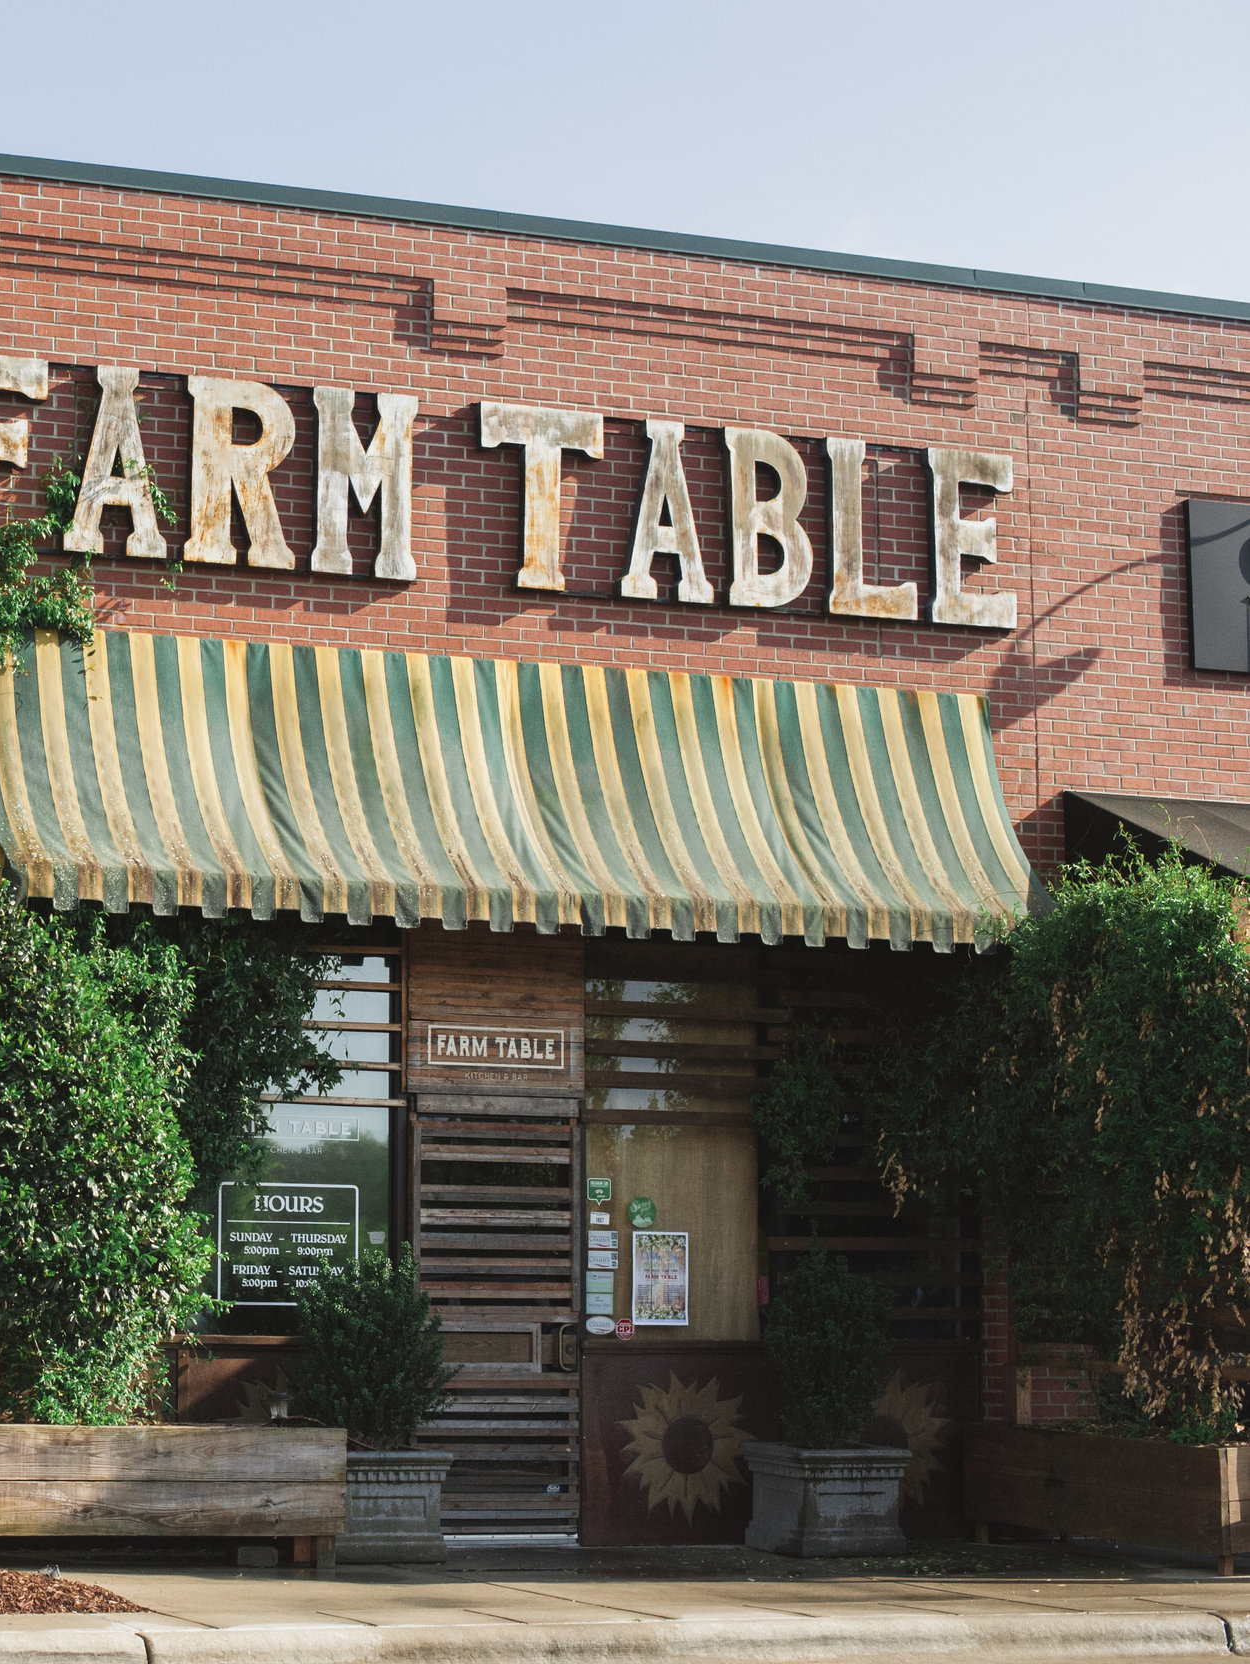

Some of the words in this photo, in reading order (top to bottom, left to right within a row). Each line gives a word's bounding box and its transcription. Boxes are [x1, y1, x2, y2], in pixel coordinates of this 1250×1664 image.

[479, 401, 1018, 629] TABLE
[437, 1034, 488, 1058] FARM
[495, 1036, 556, 1061] TABLE
[464, 1071, 501, 1080] KITCHEN
[512, 1073, 528, 1081] BAR
[288, 1119, 352, 1137] TABLE
[254, 1195, 324, 1213] HOURS
[229, 1232, 273, 1243] SUNDAY
[291, 1233, 348, 1244] THURSDAY
[243, 1246, 280, 1256] 5:00pm
[232, 1265, 271, 1276] FRIDAY
[242, 1278, 278, 1290] 5:00pm
[617, 1325, 633, 1333] CPI
